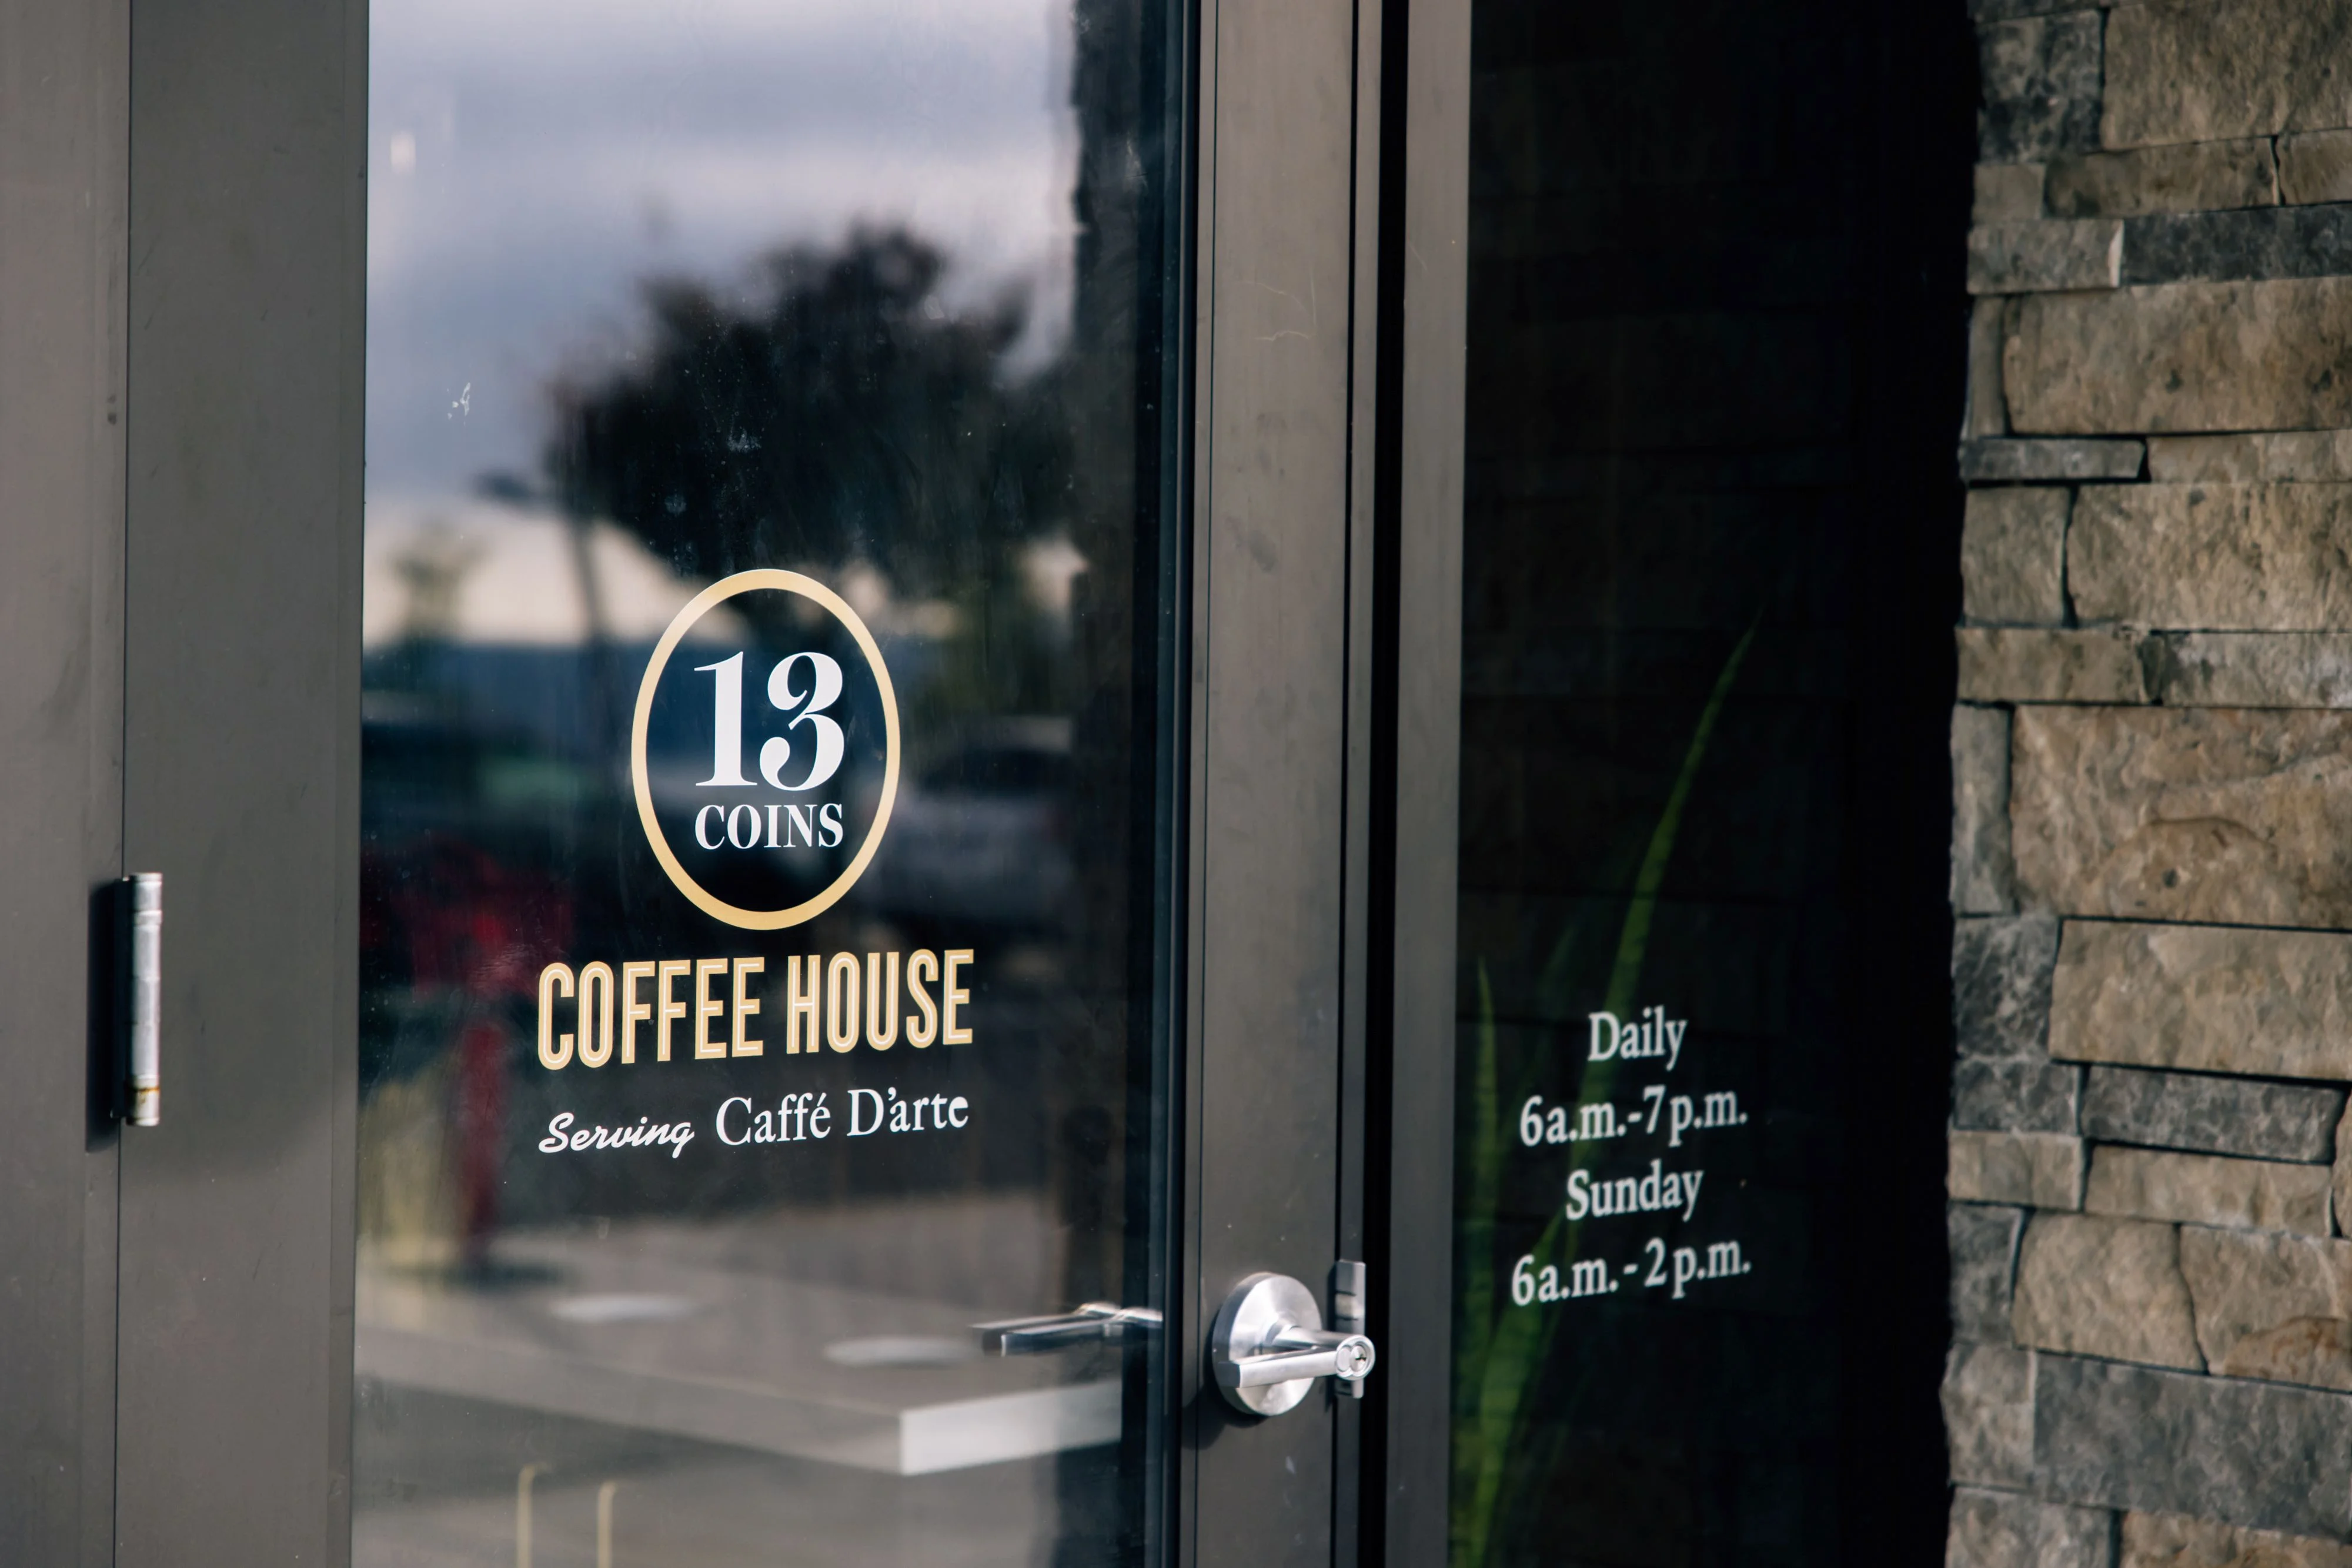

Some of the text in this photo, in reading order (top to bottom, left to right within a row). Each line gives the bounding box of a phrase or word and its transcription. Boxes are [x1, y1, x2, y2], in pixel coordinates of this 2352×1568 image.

[694, 651, 845, 792] 13
[694, 803, 843, 850] COINS
[537, 949, 974, 1071] COFFEE HOUSE
[1588, 1006, 1687, 1071] Daily
[538, 1112, 695, 1159] Serving
[716, 1091, 831, 1146] Caffé
[1566, 1159, 1703, 1221] Sunday
